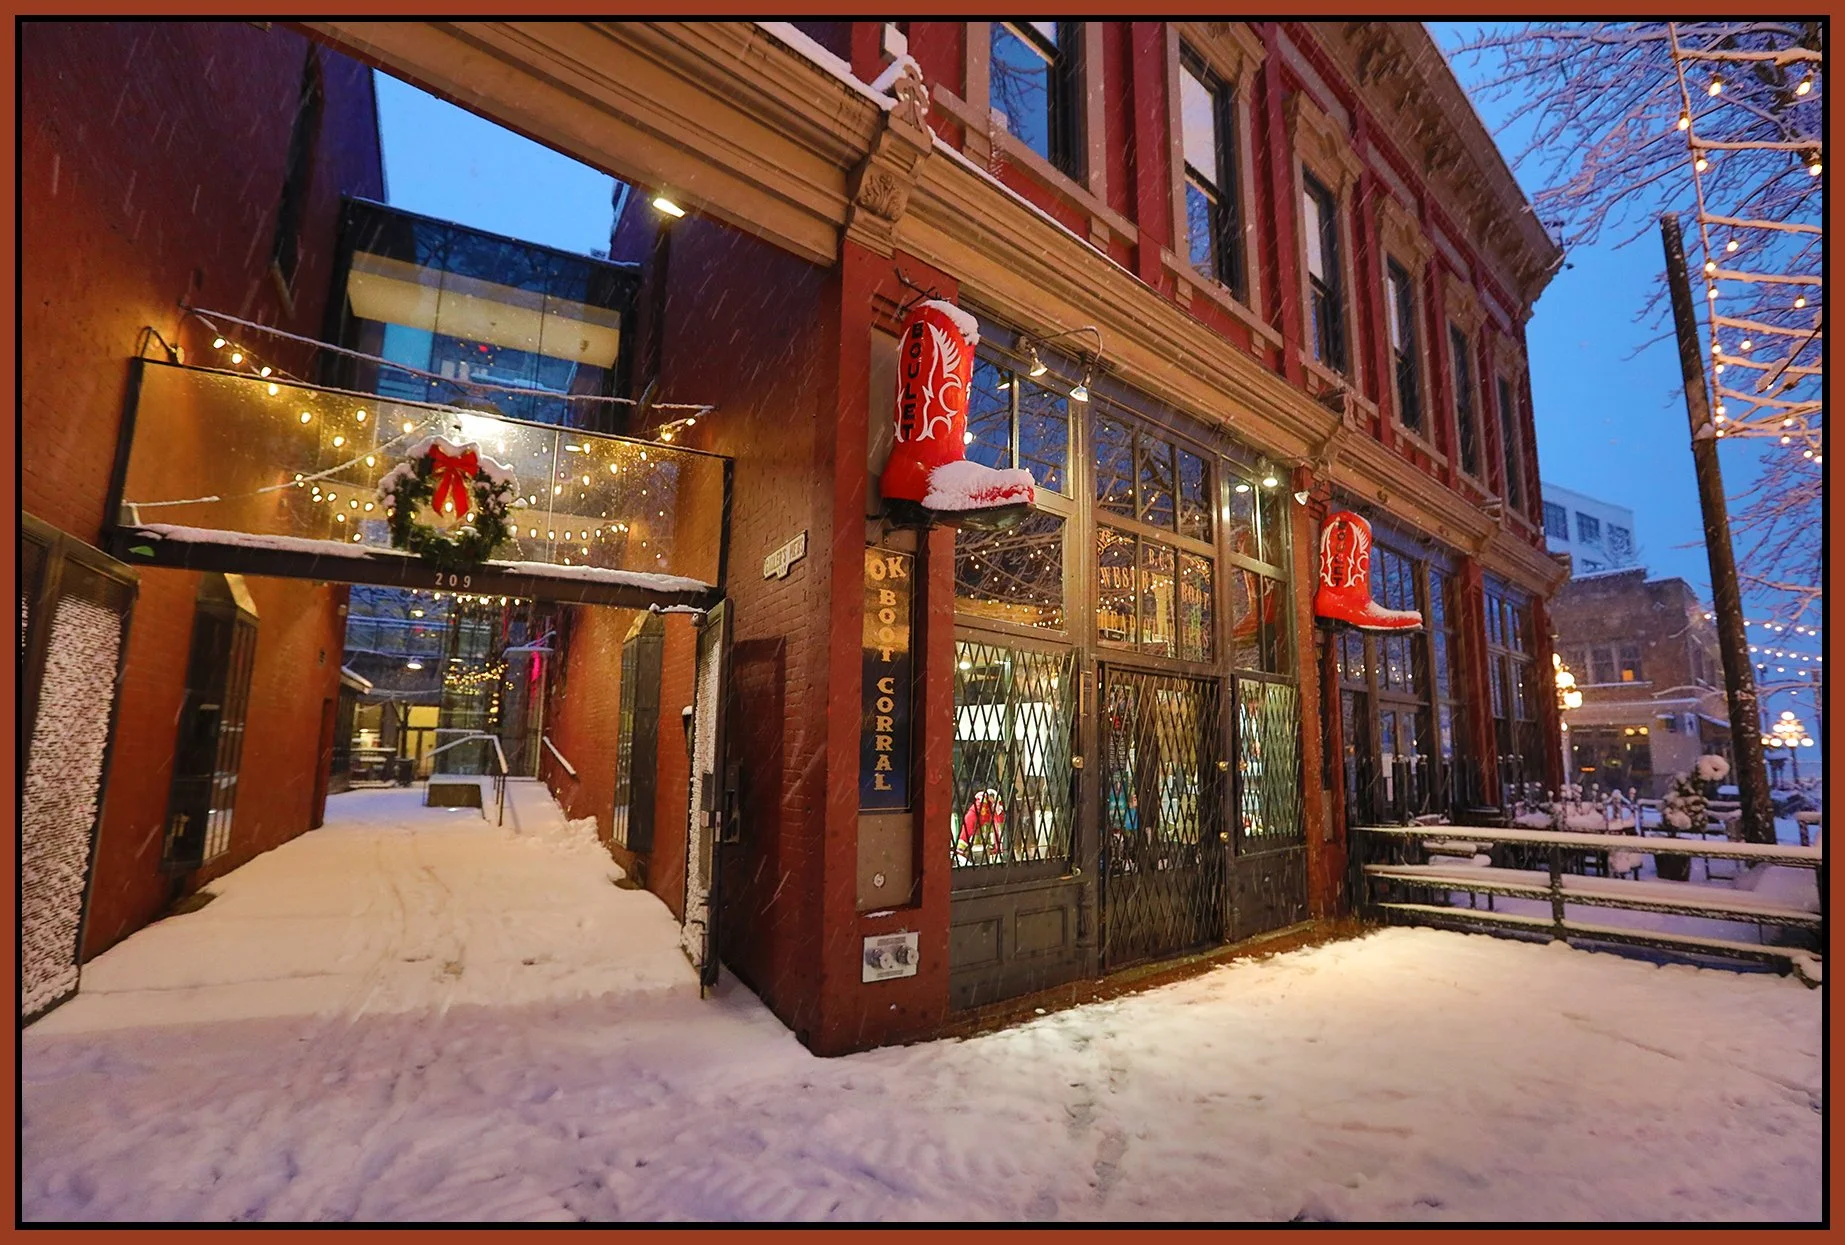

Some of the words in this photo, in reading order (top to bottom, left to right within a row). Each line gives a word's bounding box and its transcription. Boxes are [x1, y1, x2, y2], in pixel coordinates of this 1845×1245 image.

[901, 321, 925, 440] BOULET
[434, 572, 471, 588] 209
[869, 556, 907, 580] OK
[1333, 521, 1347, 586] BOULET
[878, 588, 896, 662] BOOT
[873, 677, 895, 791] CORRAL
